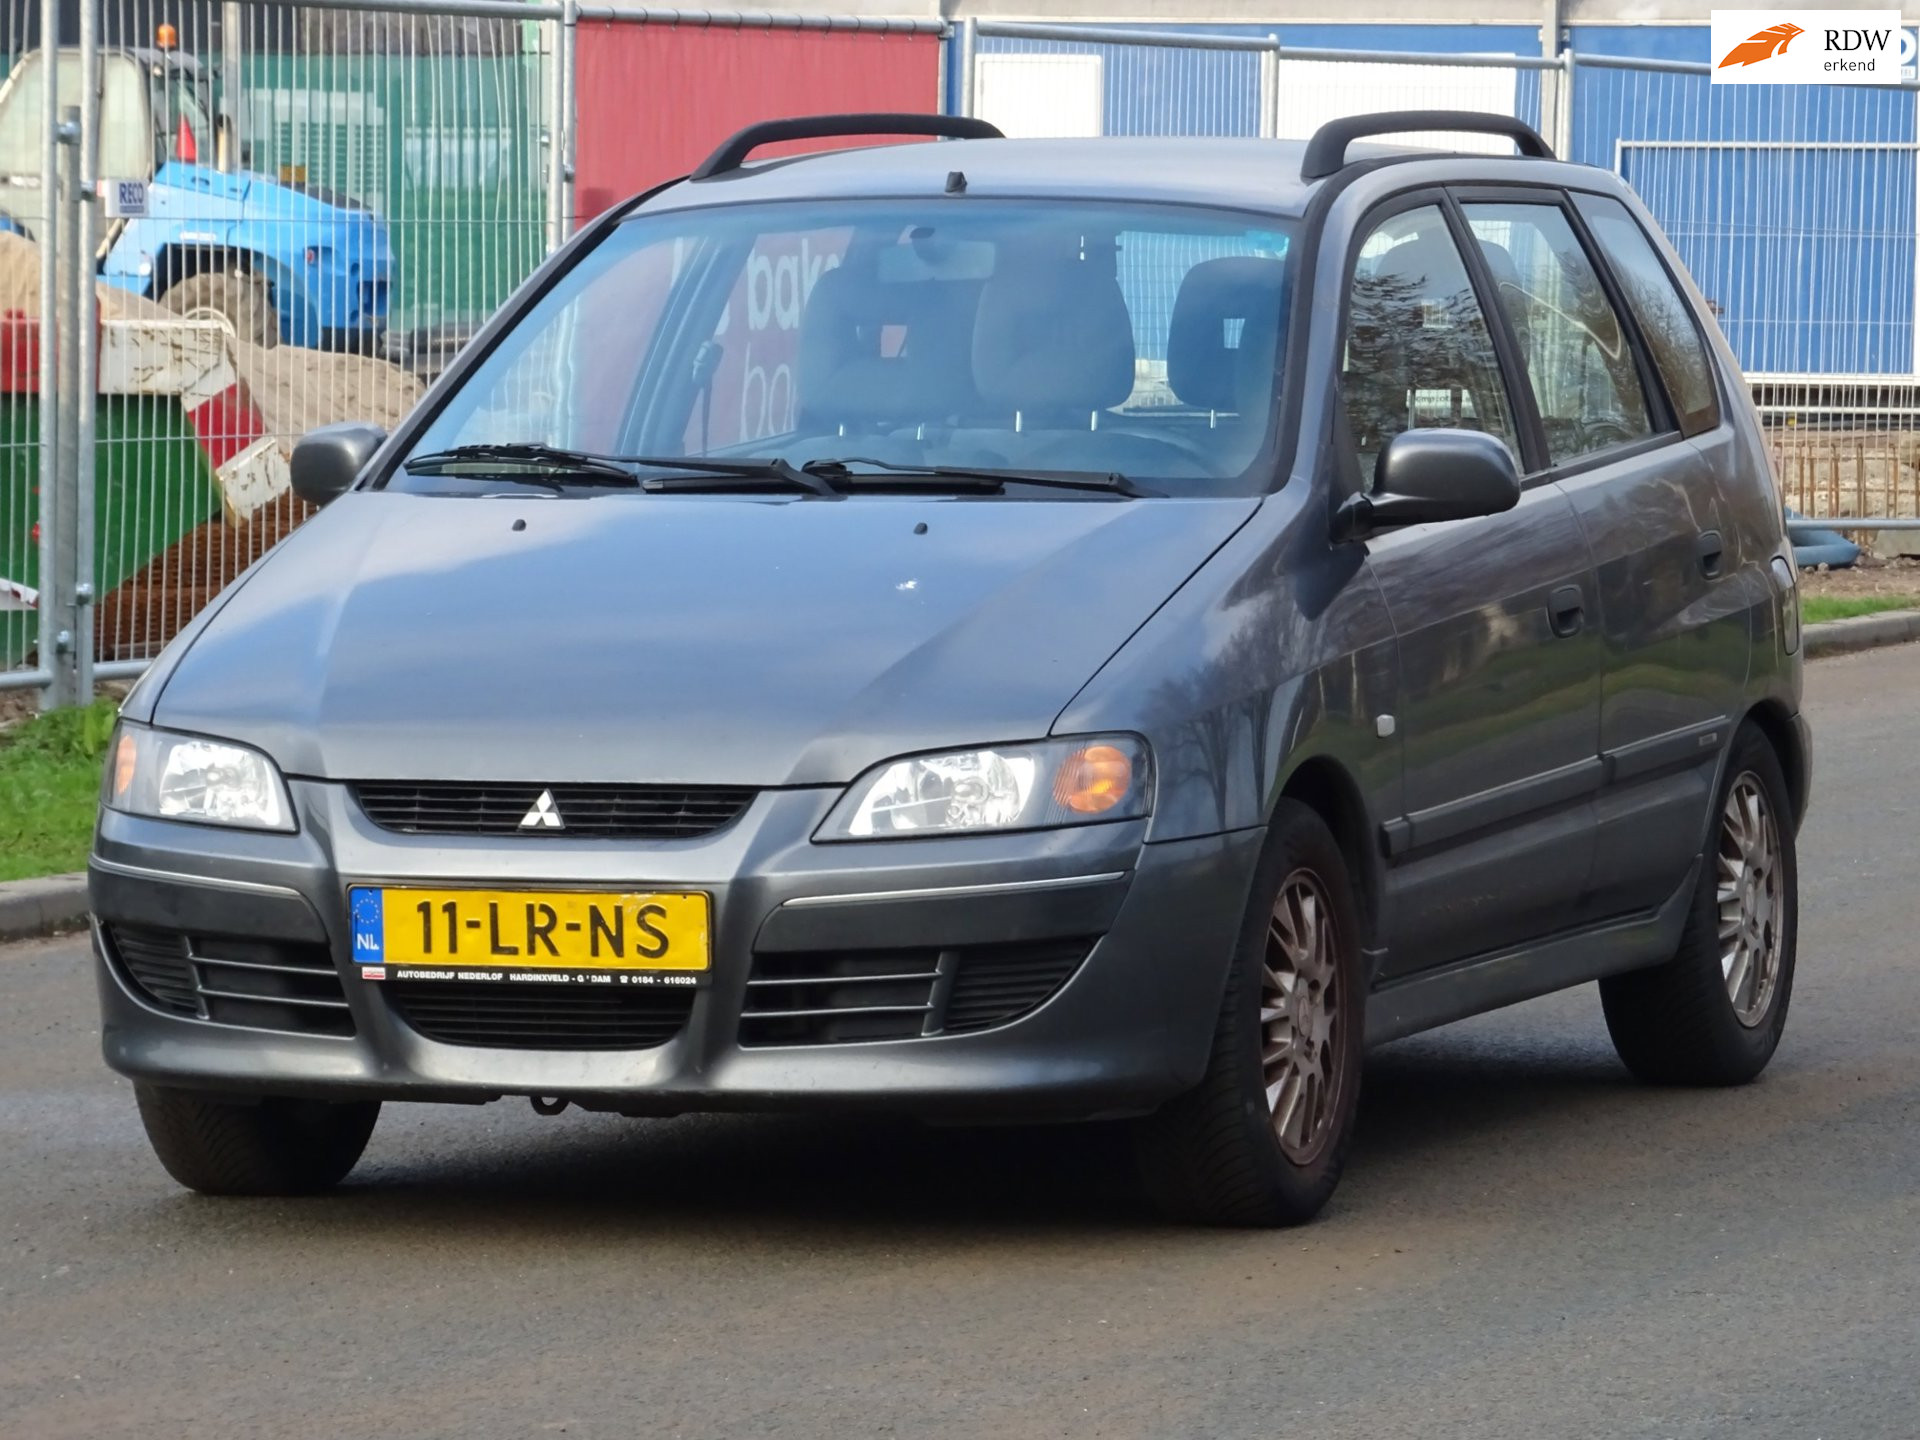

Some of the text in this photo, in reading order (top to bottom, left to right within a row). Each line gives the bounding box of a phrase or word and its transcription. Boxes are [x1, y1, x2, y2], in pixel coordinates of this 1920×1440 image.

[417, 900, 670, 959] 11-LR-NS
[357, 933, 380, 950] NL
[397, 970, 455, 980] AUTOBEDRIJF
[458, 972, 503, 980] NEDERLOF
[510, 973, 569, 983] HARDINXVELD
